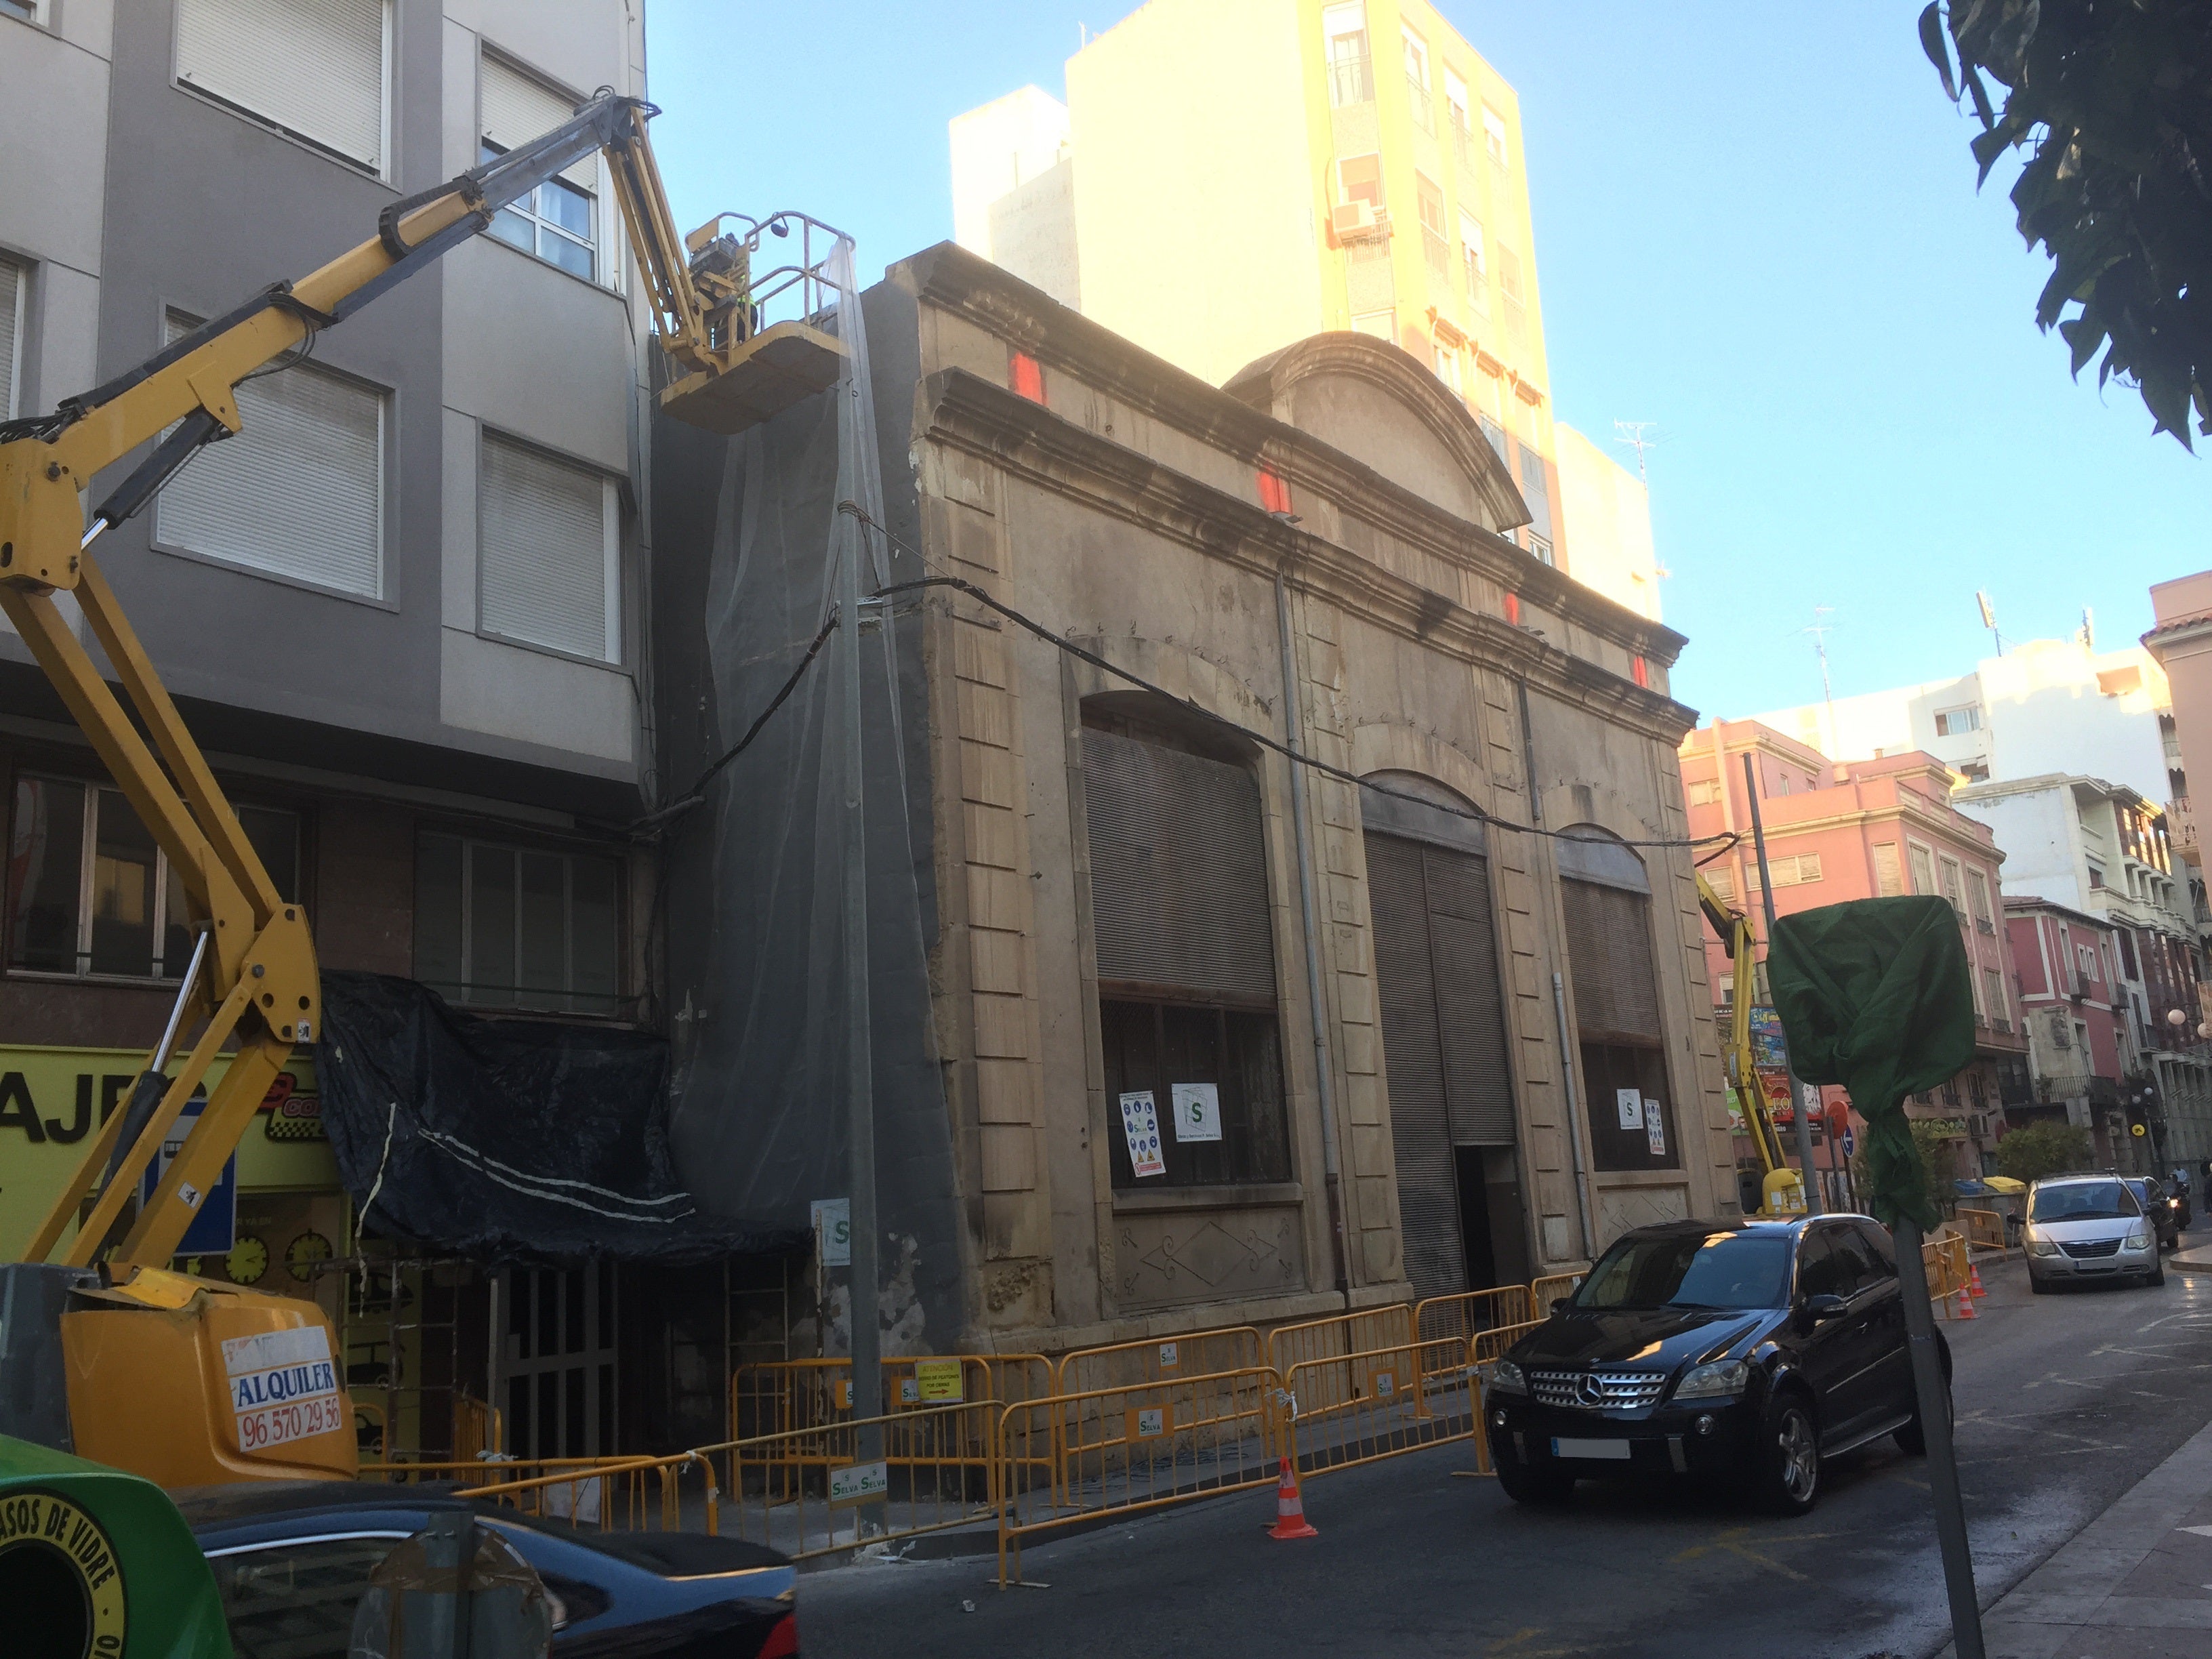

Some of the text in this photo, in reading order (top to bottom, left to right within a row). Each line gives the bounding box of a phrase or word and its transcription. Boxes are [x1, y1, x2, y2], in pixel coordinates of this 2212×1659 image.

[1192, 1102, 1202, 1122] S
[1627, 1102, 1633, 1116] S
[836, 1221, 849, 1244] S
[238, 1363, 334, 1408] ALQUILER
[243, 1398, 339, 1448] 96 570 29 56
[1141, 1420, 1161, 1432] SELVA
[832, 1482, 859, 1496] SELVA
[861, 1477, 886, 1490] SELVA
[44, 1503, 71, 1542] DE
[68, 1517, 115, 1590] VIDRE
